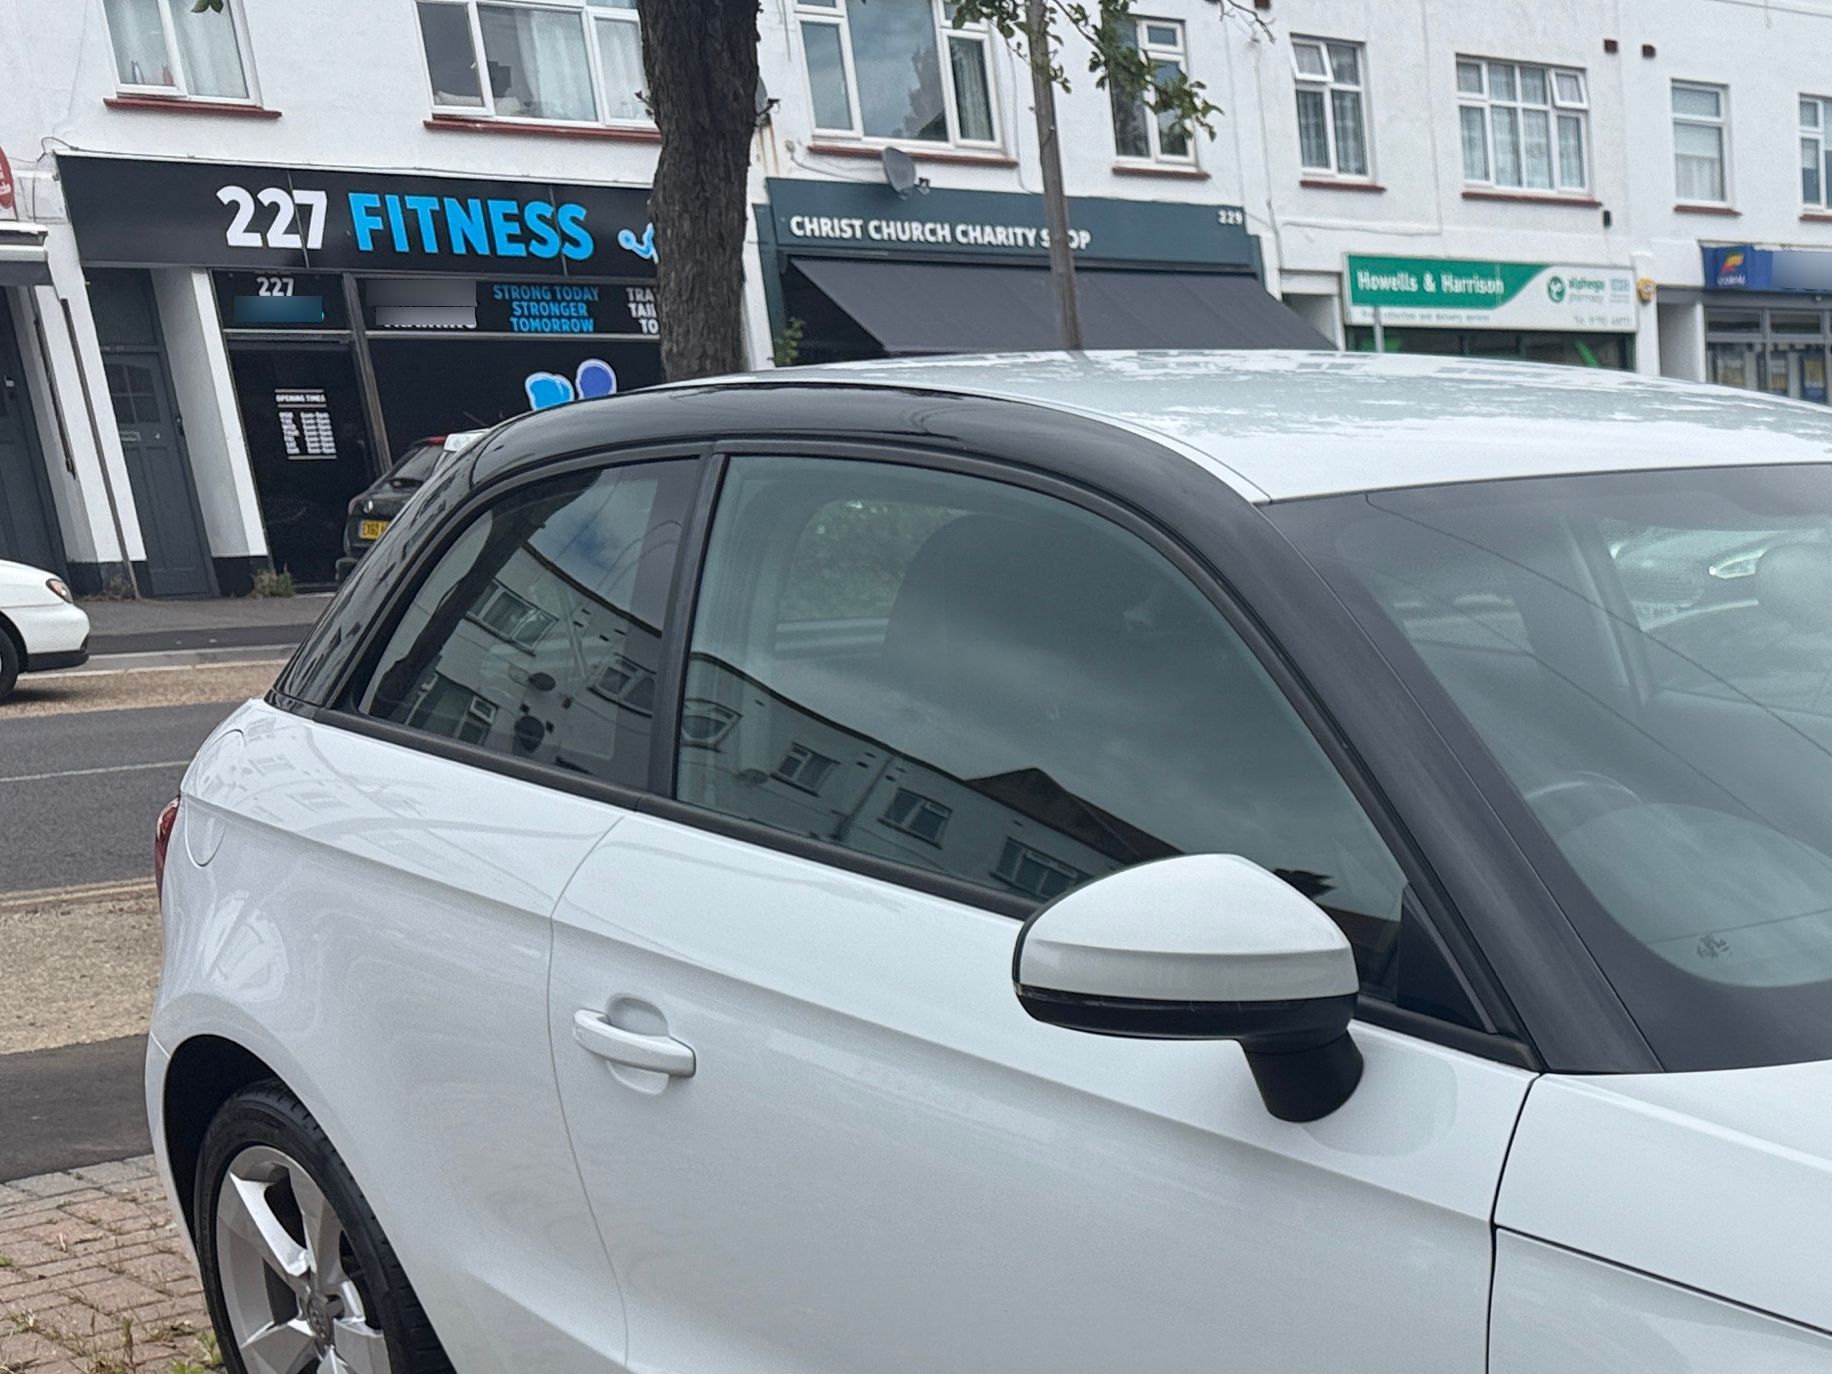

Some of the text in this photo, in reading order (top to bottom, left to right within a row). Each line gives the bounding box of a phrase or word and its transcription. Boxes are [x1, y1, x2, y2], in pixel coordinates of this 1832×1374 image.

[216, 185, 594, 261] 227 FITNESS
[790, 215, 1091, 250] CHRIST CHURCH CHARITY SOP
[256, 276, 294, 297] 227
[493, 284, 600, 301] STRONG TODAY
[1356, 270, 1504, 294] Howells & Harrison
[511, 302, 588, 317] STRONGER
[509, 317, 594, 333] TOMORROW
